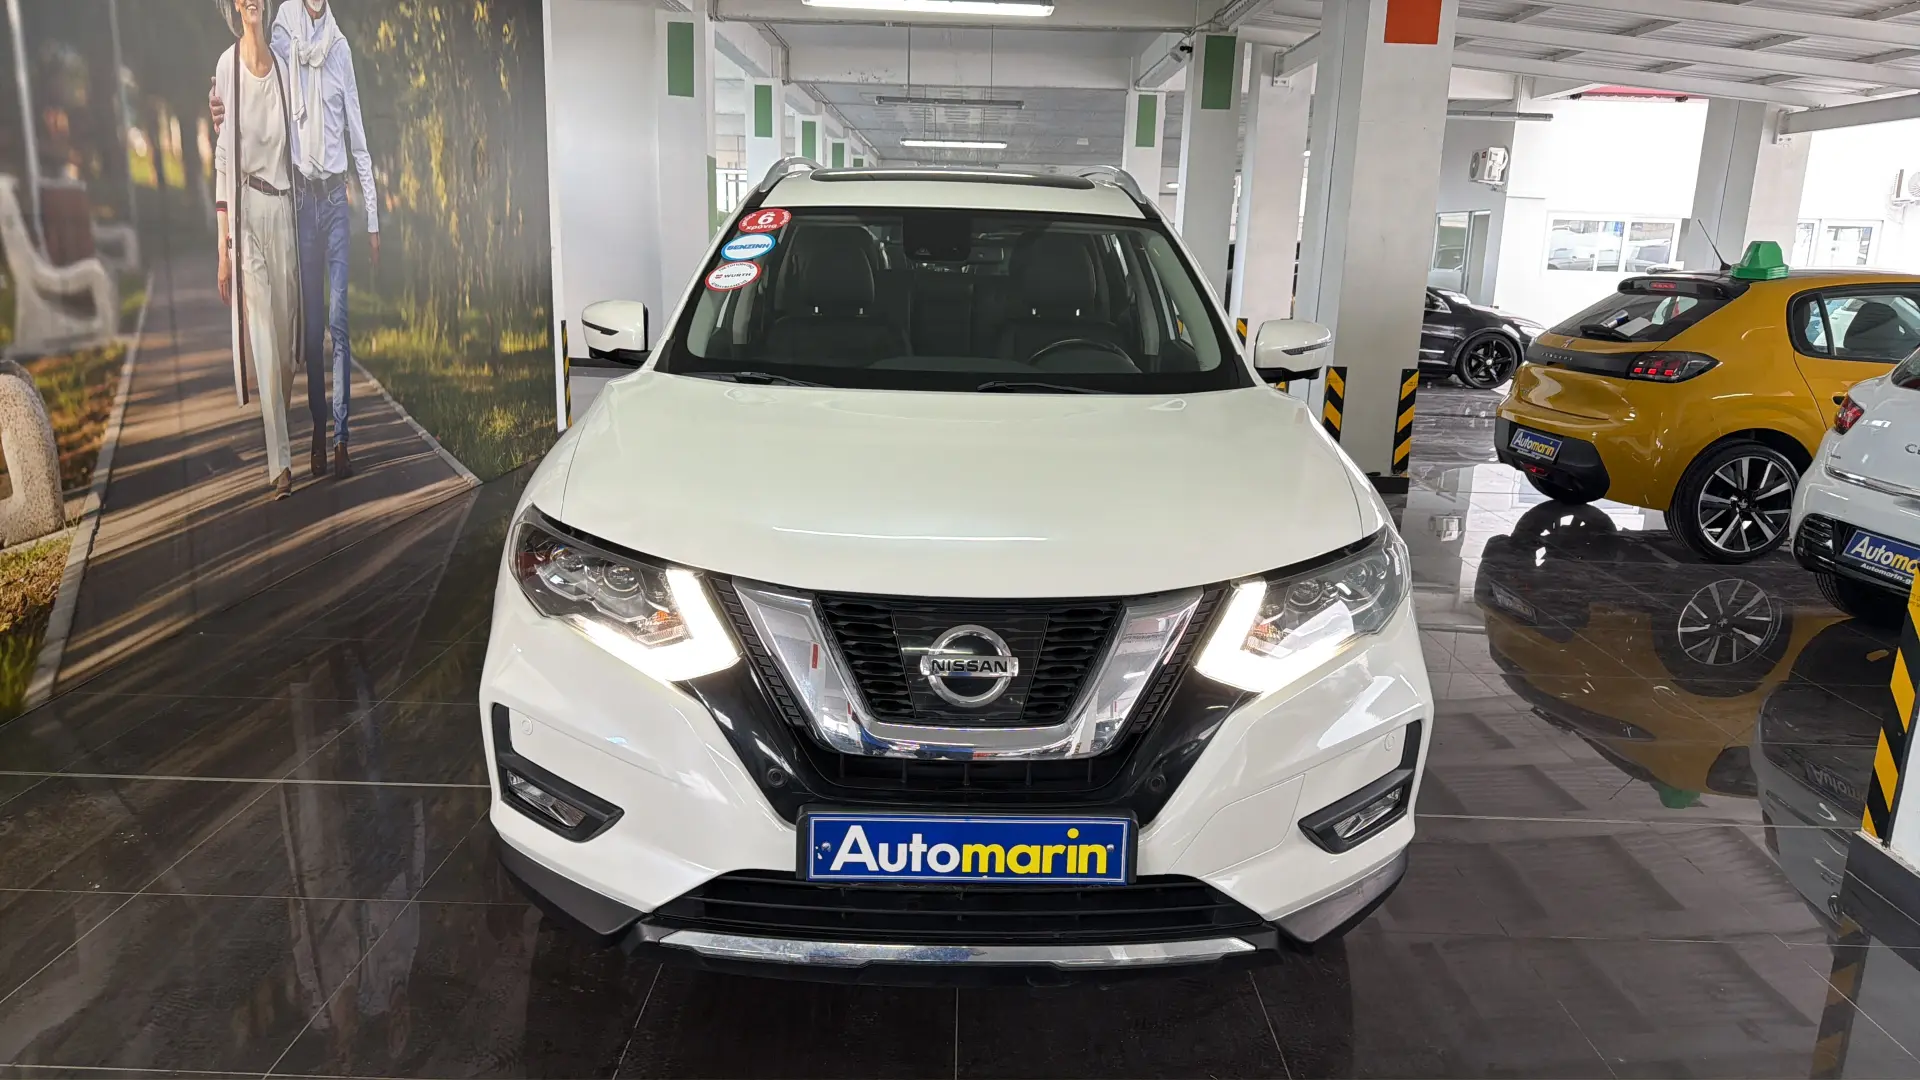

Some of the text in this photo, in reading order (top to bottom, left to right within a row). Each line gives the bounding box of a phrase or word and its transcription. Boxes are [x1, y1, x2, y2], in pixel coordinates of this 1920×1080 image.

[757, 213, 776, 225] 6
[1513, 431, 1555, 457] Automarin
[930, 659, 1009, 673] NISSAN
[829, 824, 1108, 875] Automarin
